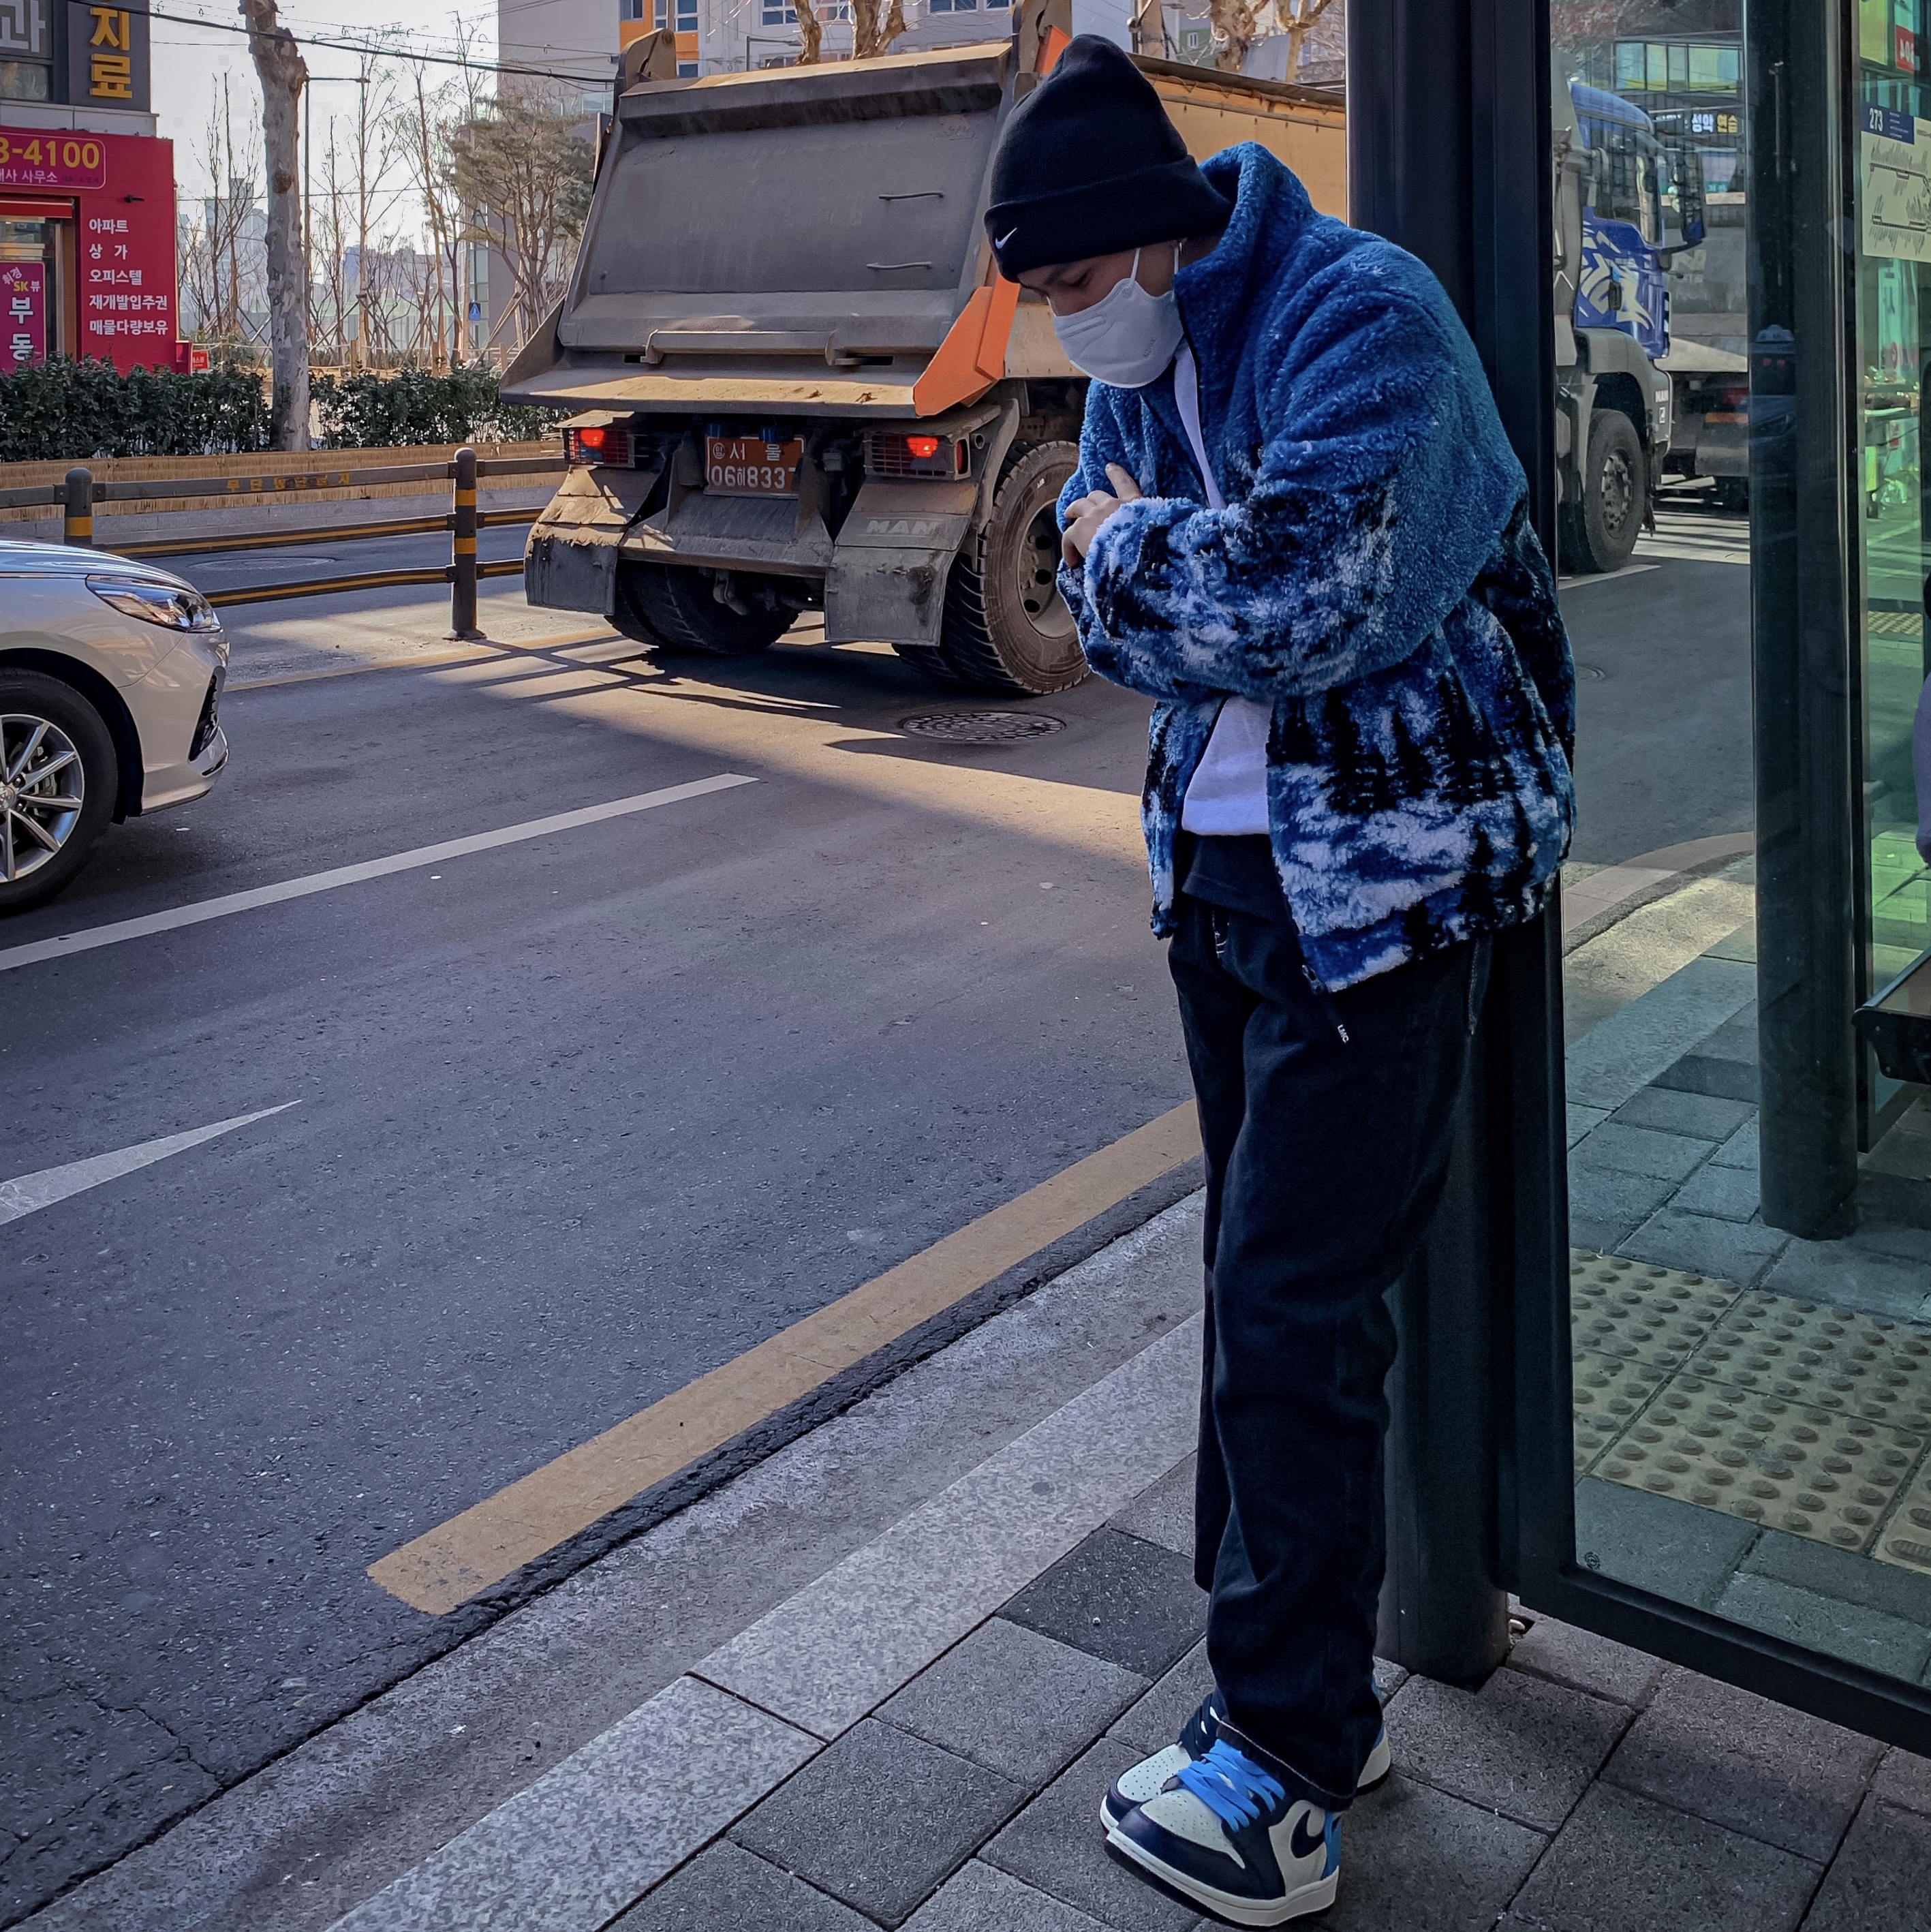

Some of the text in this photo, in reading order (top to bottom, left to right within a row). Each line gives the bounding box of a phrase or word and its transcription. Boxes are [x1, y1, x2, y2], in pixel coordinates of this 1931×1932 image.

[0, 0, 45, 52] 과
[1869, 108, 1883, 132] 273
[22, 170, 58, 183] 사무소
[89, 218, 129, 234] 아파트
[89, 269, 142, 286] 오피스텔
[89, 294, 168, 310] 재개발입주권
[89, 319, 168, 335] 매물다량보유
[865, 520, 938, 534] MAN
[1337, 1024, 1349, 1043] LMC
